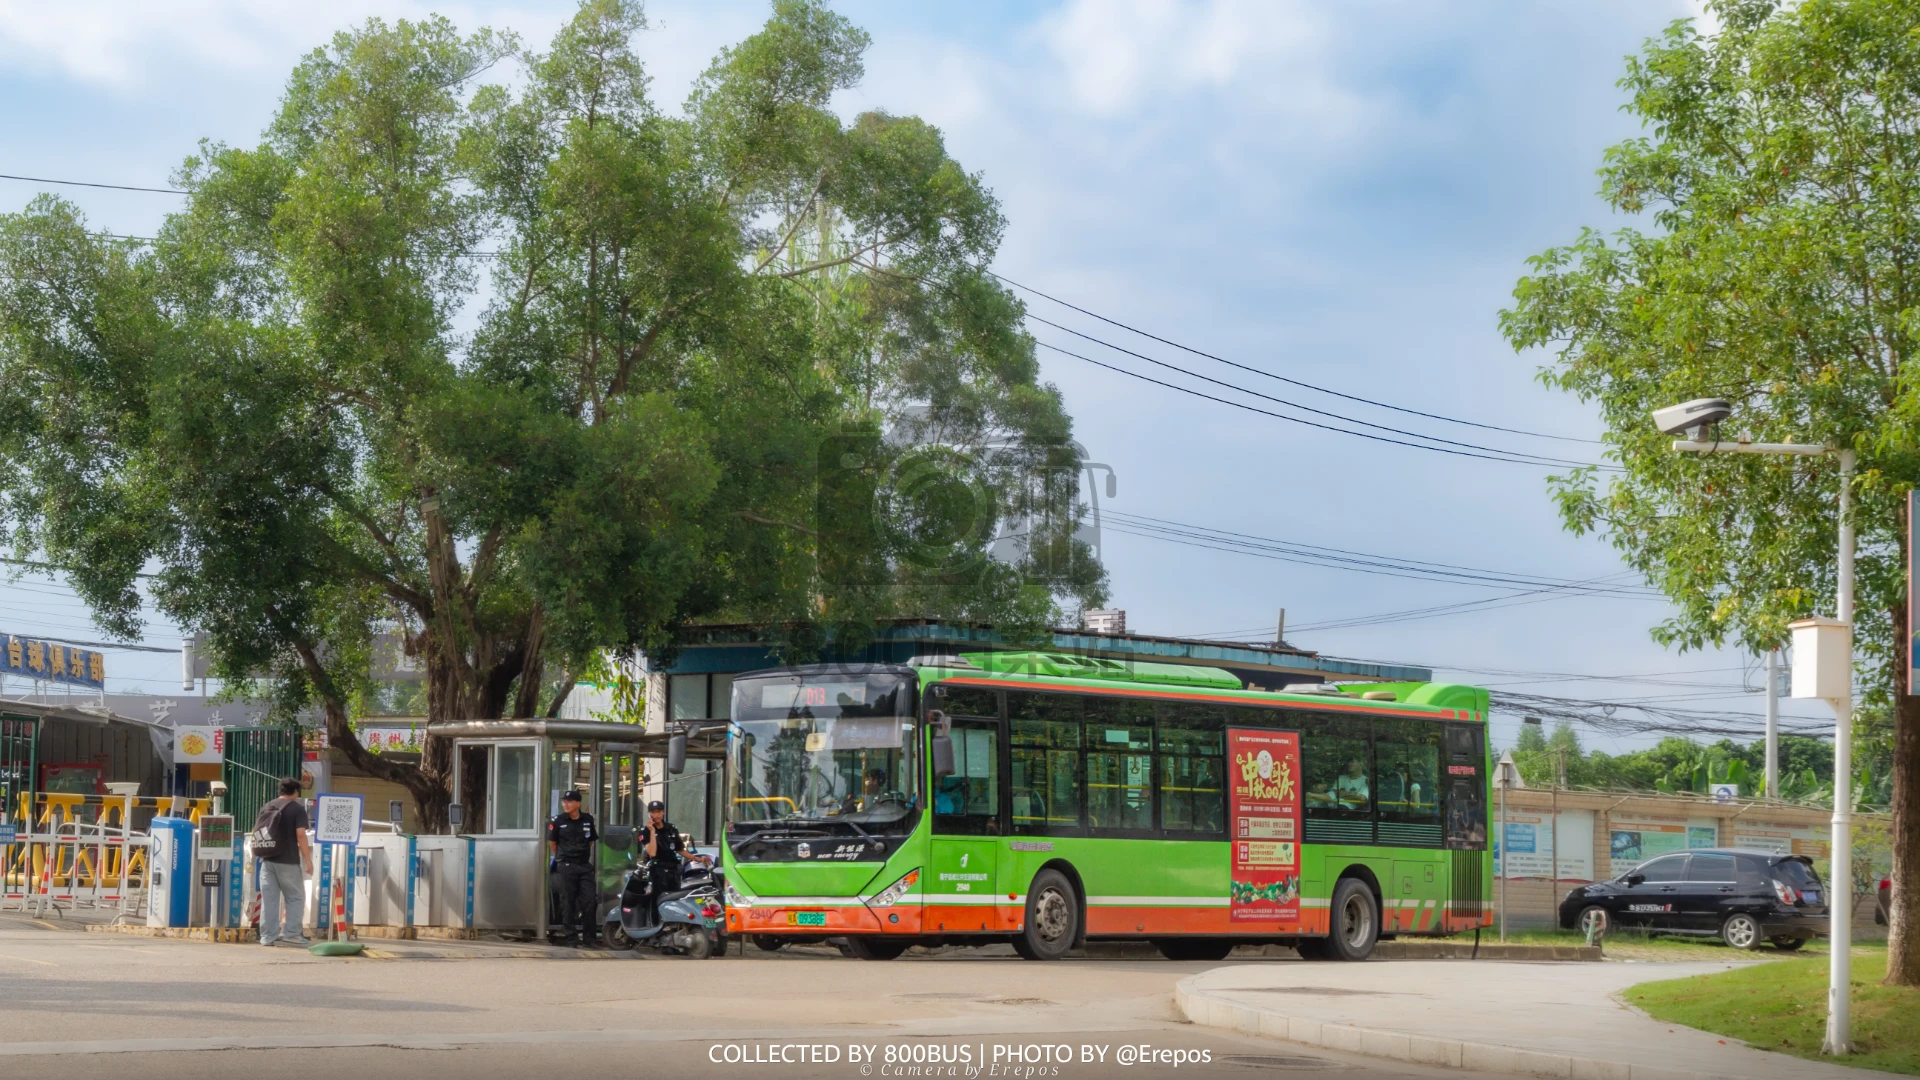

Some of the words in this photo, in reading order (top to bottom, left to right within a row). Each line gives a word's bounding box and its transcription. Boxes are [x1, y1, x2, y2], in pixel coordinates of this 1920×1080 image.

[0, 635, 105, 682] 台球俱乐部
[749, 909, 773, 920] 2940
